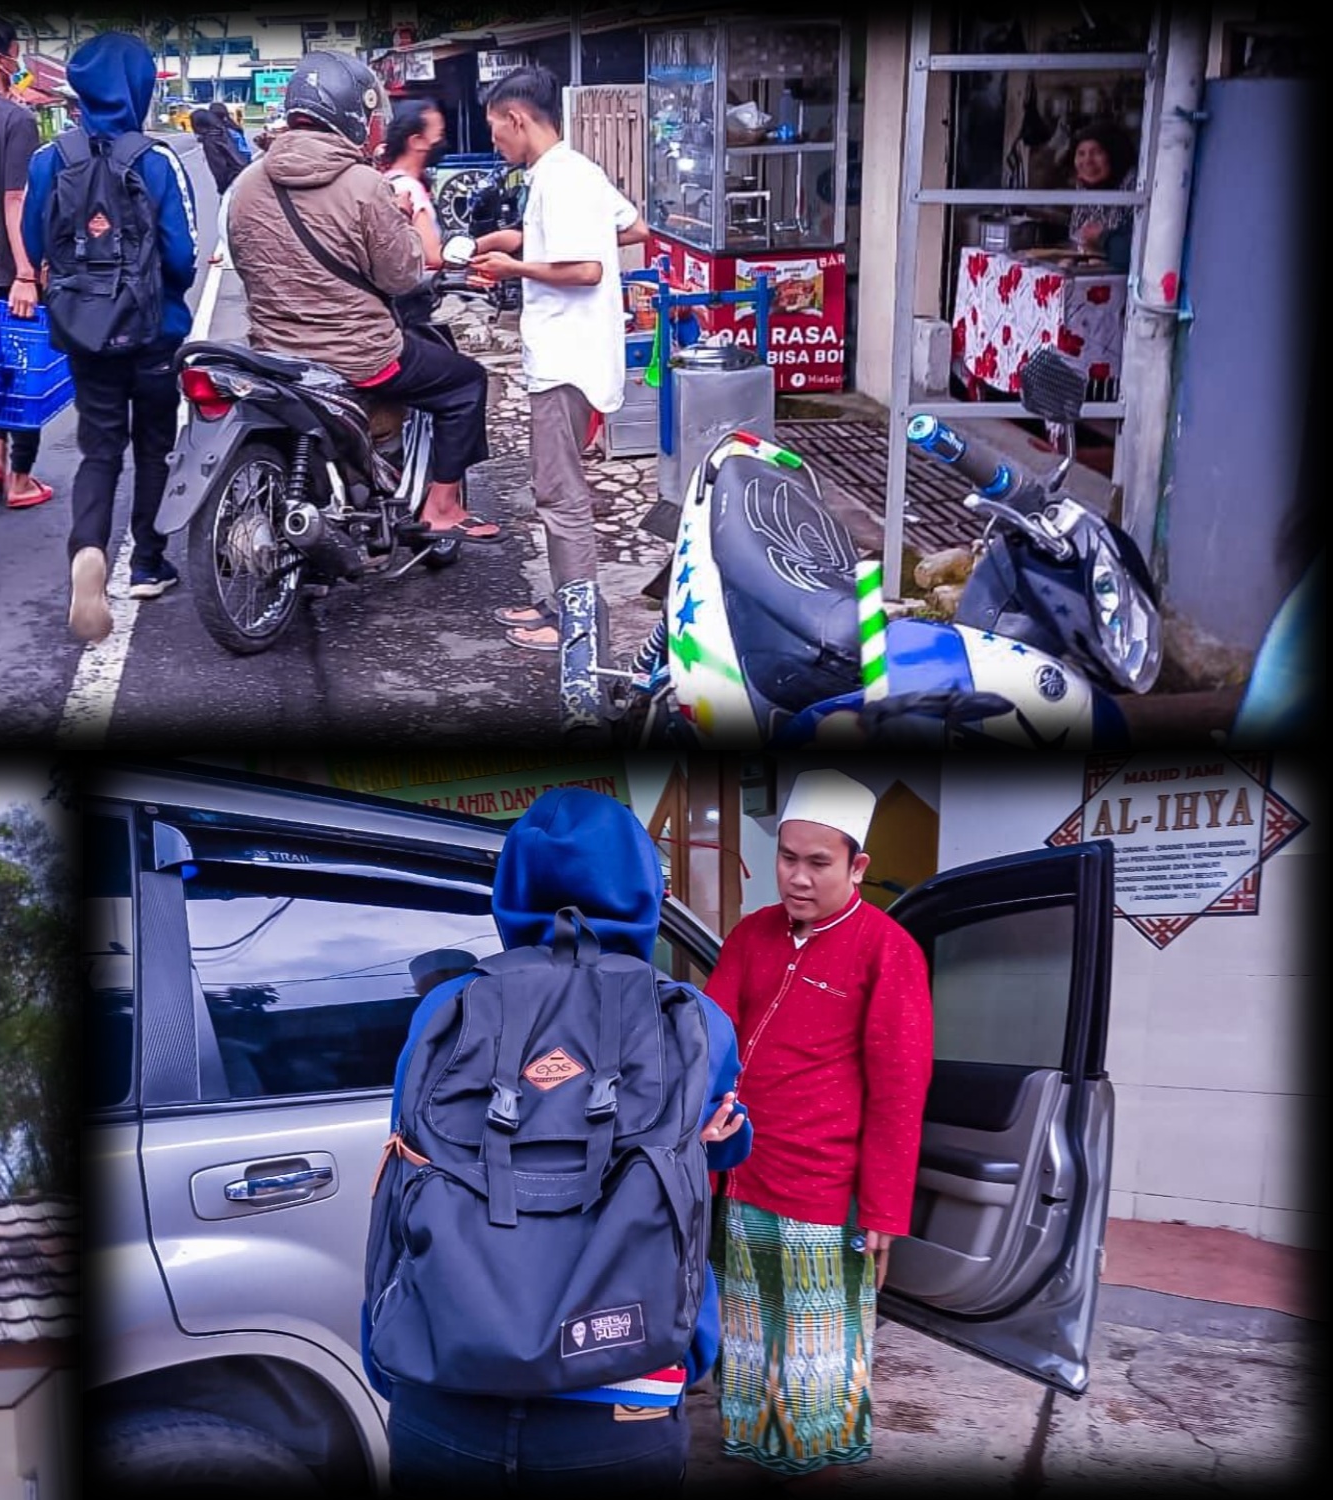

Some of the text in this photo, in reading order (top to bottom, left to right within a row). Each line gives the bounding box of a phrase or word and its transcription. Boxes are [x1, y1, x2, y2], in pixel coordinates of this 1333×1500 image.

[767, 349, 810, 365] BISA
[1124, 763, 1225, 785] MASJID JAMI
[500, 786, 536, 811] DAN
[1091, 787, 1255, 837] AL-IHYA
